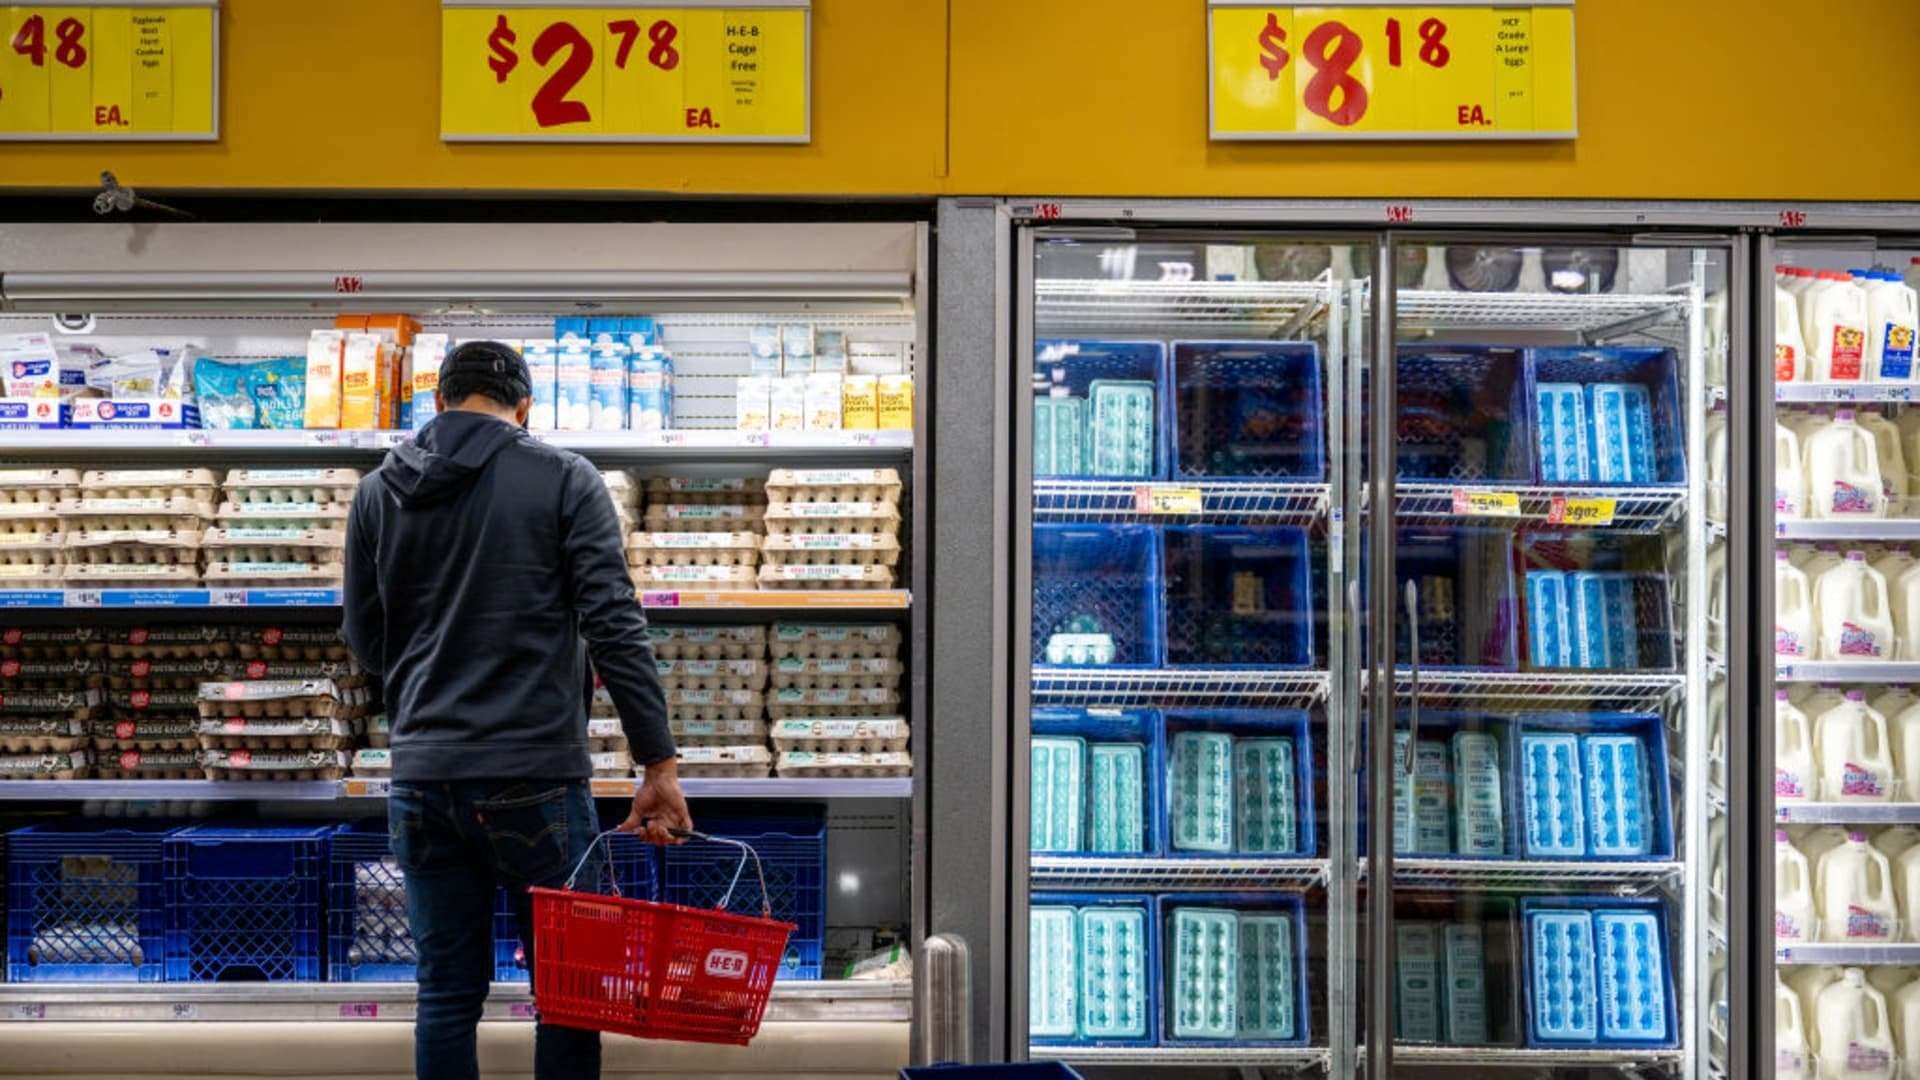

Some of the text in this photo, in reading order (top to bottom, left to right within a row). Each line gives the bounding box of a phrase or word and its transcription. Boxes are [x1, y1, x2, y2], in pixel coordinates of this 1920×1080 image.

[726, 26, 760, 37] H-E-B
[728, 43, 757, 56] Cage
[730, 60, 757, 71] Free
[95, 105, 129, 126] EA.
[685, 107, 721, 128] EA.
[1457, 105, 1492, 126] EA.
[335, 276, 363, 293] A12
